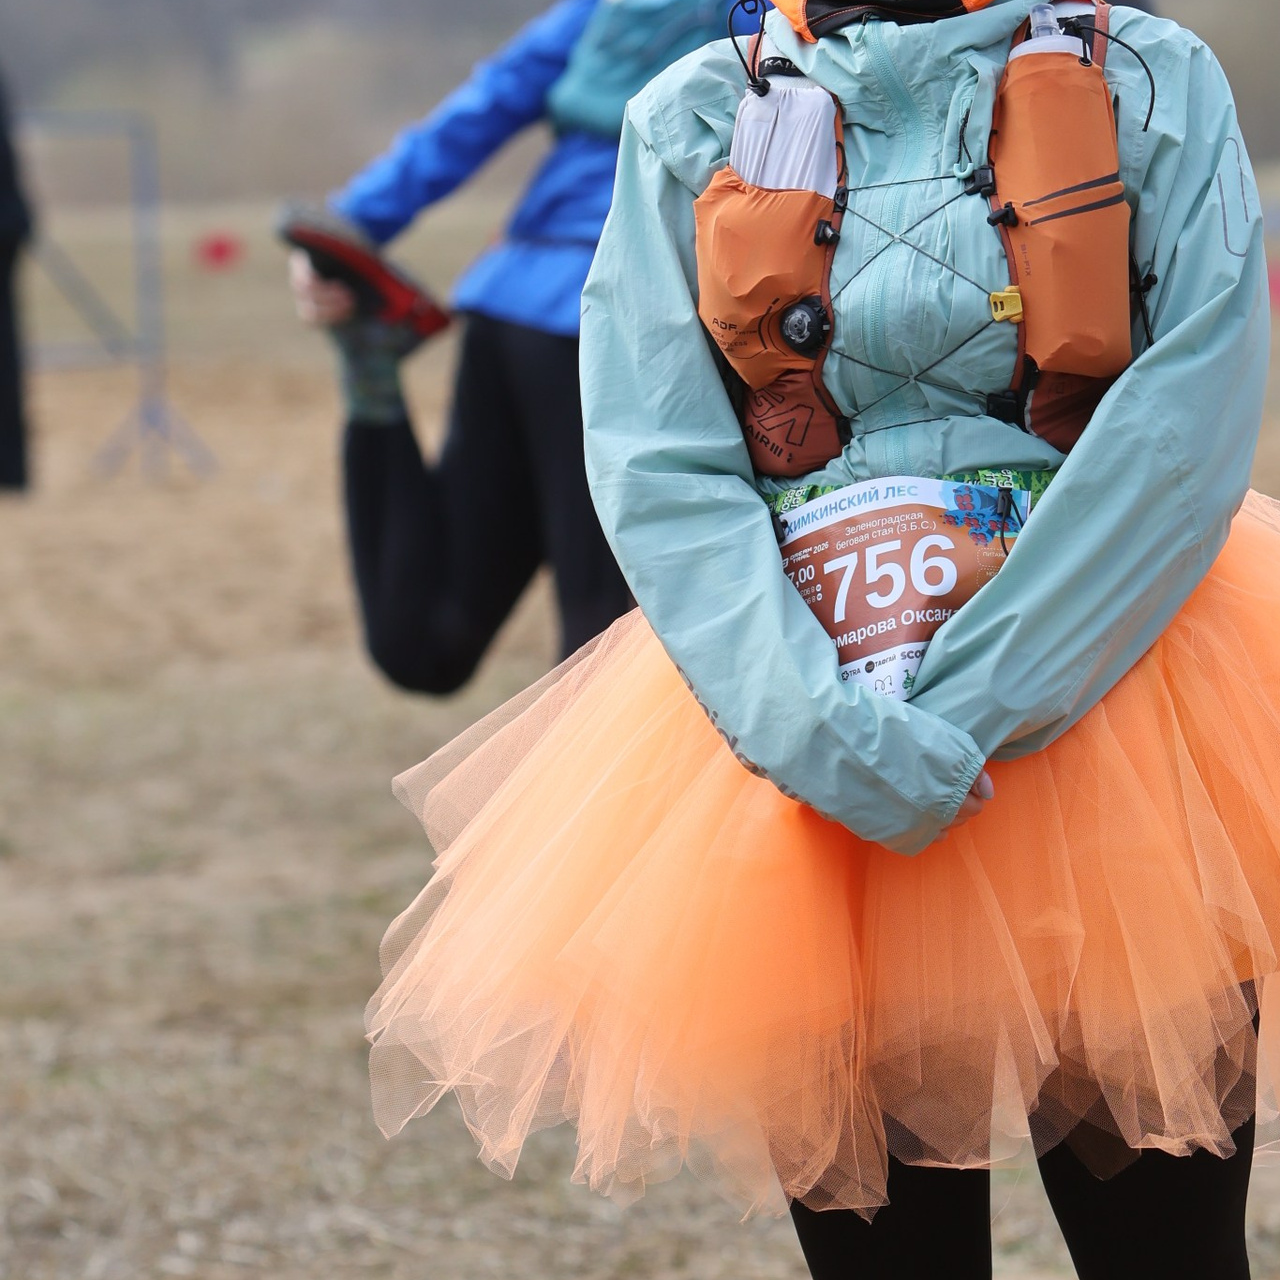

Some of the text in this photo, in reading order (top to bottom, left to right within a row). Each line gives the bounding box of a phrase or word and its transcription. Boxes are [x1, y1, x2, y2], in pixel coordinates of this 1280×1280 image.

[712, 318, 737, 330] ADF
[786, 486, 879, 536] ХИМКИНСКИЙ
[883, 485, 918, 500] ЛЕС
[845, 511, 924, 536] Зеленоградская
[812, 541, 829, 555] 2026
[835, 520, 937, 550] беговая стая (З.Б.С.)
[823, 534, 957, 623] 756
